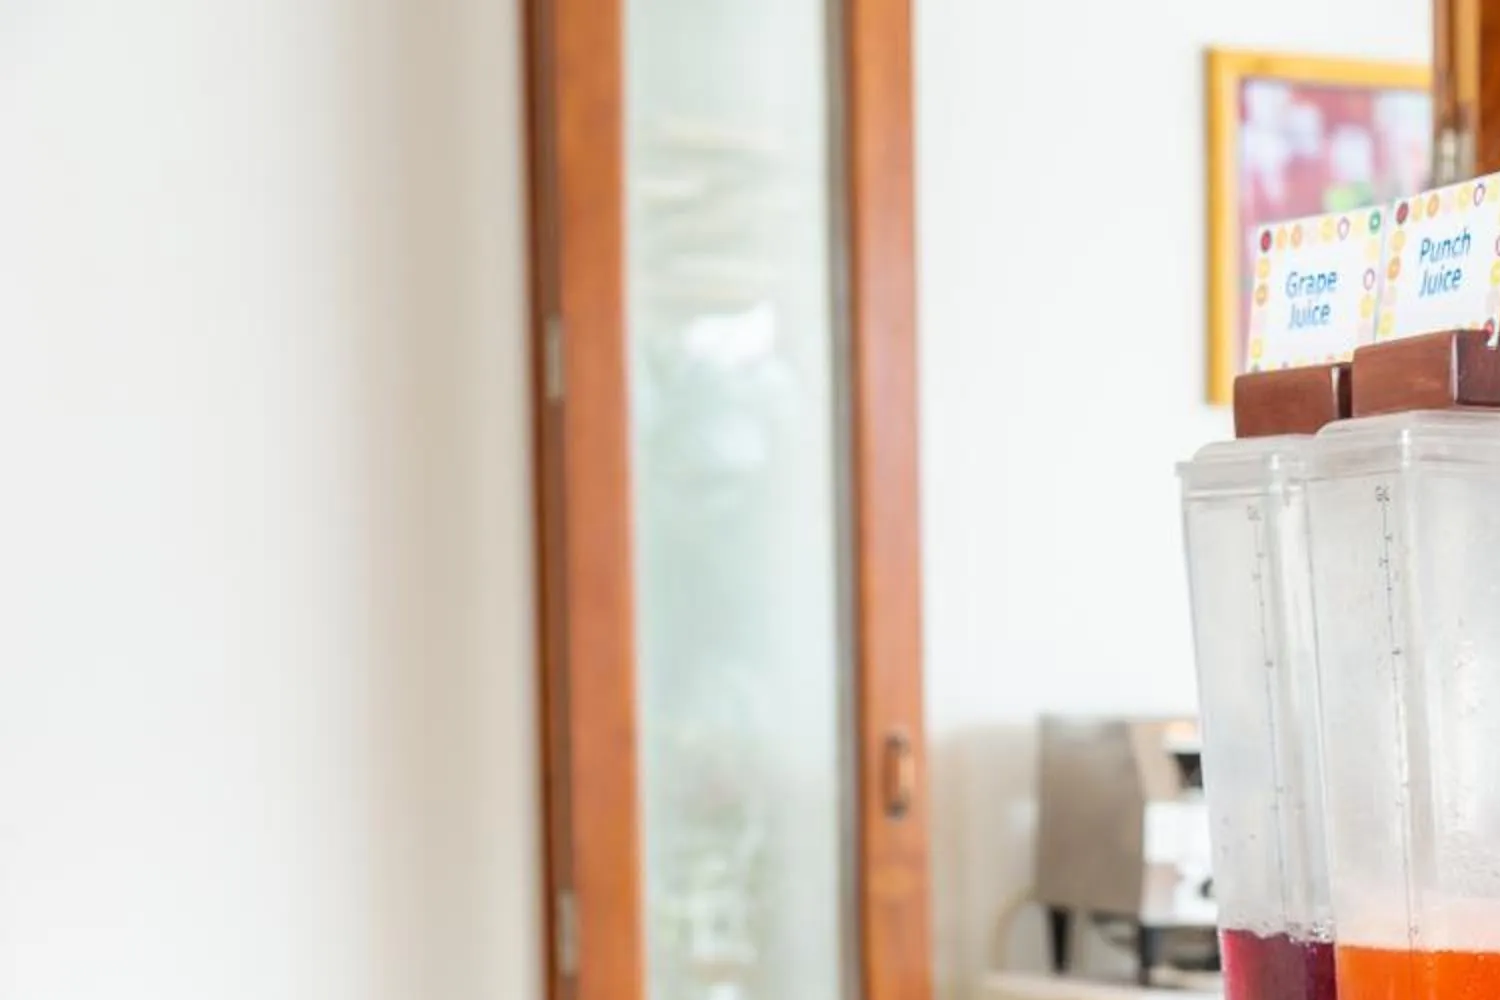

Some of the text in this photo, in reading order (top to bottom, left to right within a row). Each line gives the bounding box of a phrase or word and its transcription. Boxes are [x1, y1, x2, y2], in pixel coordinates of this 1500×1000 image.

[1418, 228, 1472, 262] Punch
[1285, 270, 1338, 299] Grape
[1418, 266, 1463, 298] Juice
[1287, 303, 1332, 330] Juice
